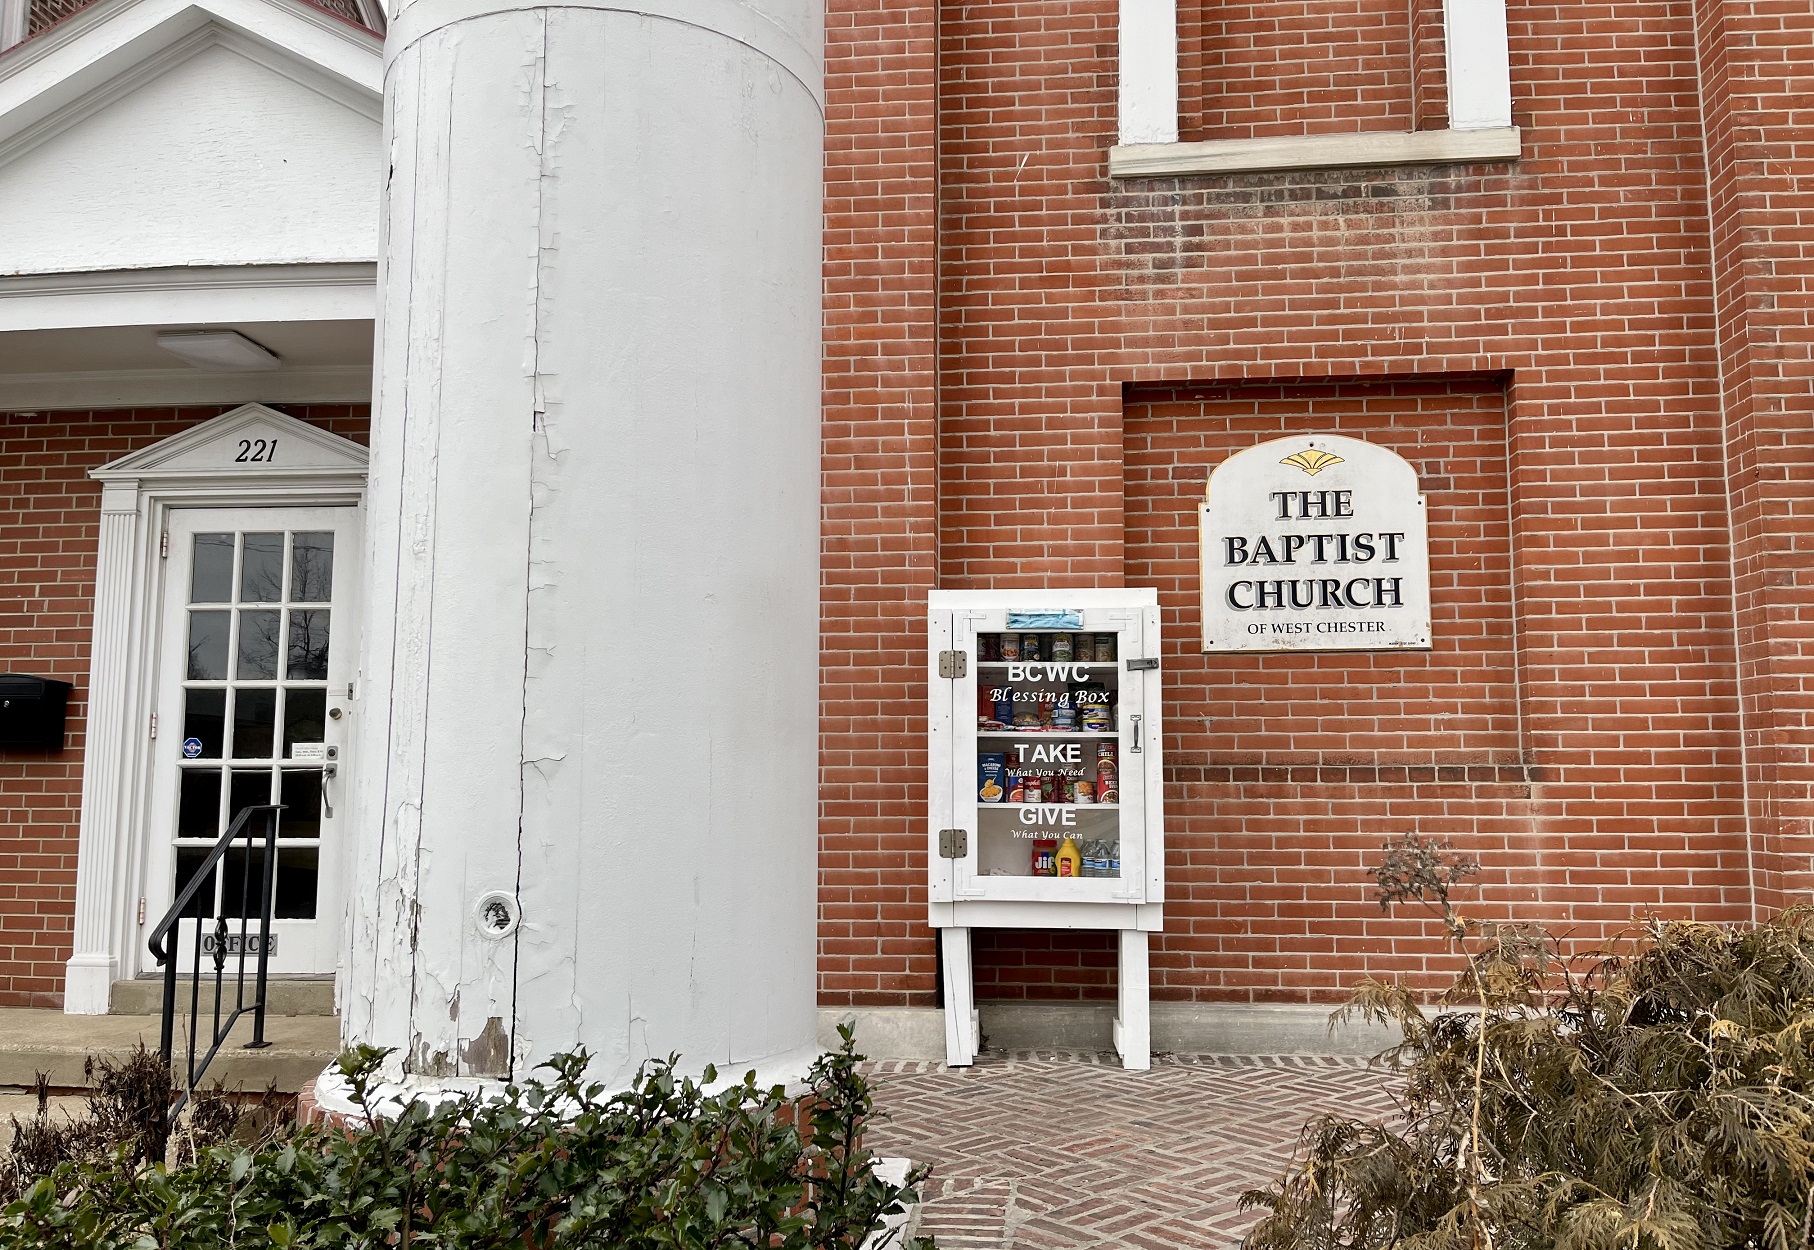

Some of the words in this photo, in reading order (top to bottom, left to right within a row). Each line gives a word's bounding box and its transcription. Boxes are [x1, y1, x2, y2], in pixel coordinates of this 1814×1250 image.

[235, 439, 278, 462] 221
[1269, 489, 1354, 521] THE
[1221, 532, 1405, 567] BAPTIST
[1225, 577, 1404, 612] CHURCH
[1247, 623, 1268, 635] OF
[1271, 622, 1313, 634] WEST
[1316, 621, 1386, 633] CHESTER
[1007, 661, 1090, 682] BCWC
[989, 686, 1070, 707] Blessing
[1074, 690, 1110, 704] Box
[1014, 744, 1082, 763] TAKE
[1004, 768, 1033, 777] What
[1035, 768, 1055, 778] You
[1057, 767, 1086, 777] Need
[1019, 807, 1077, 826] GIVE
[1011, 830, 1039, 839] What
[1041, 831, 1061, 841] You
[1063, 831, 1083, 840] Can
[1034, 856, 1055, 869] Jif
